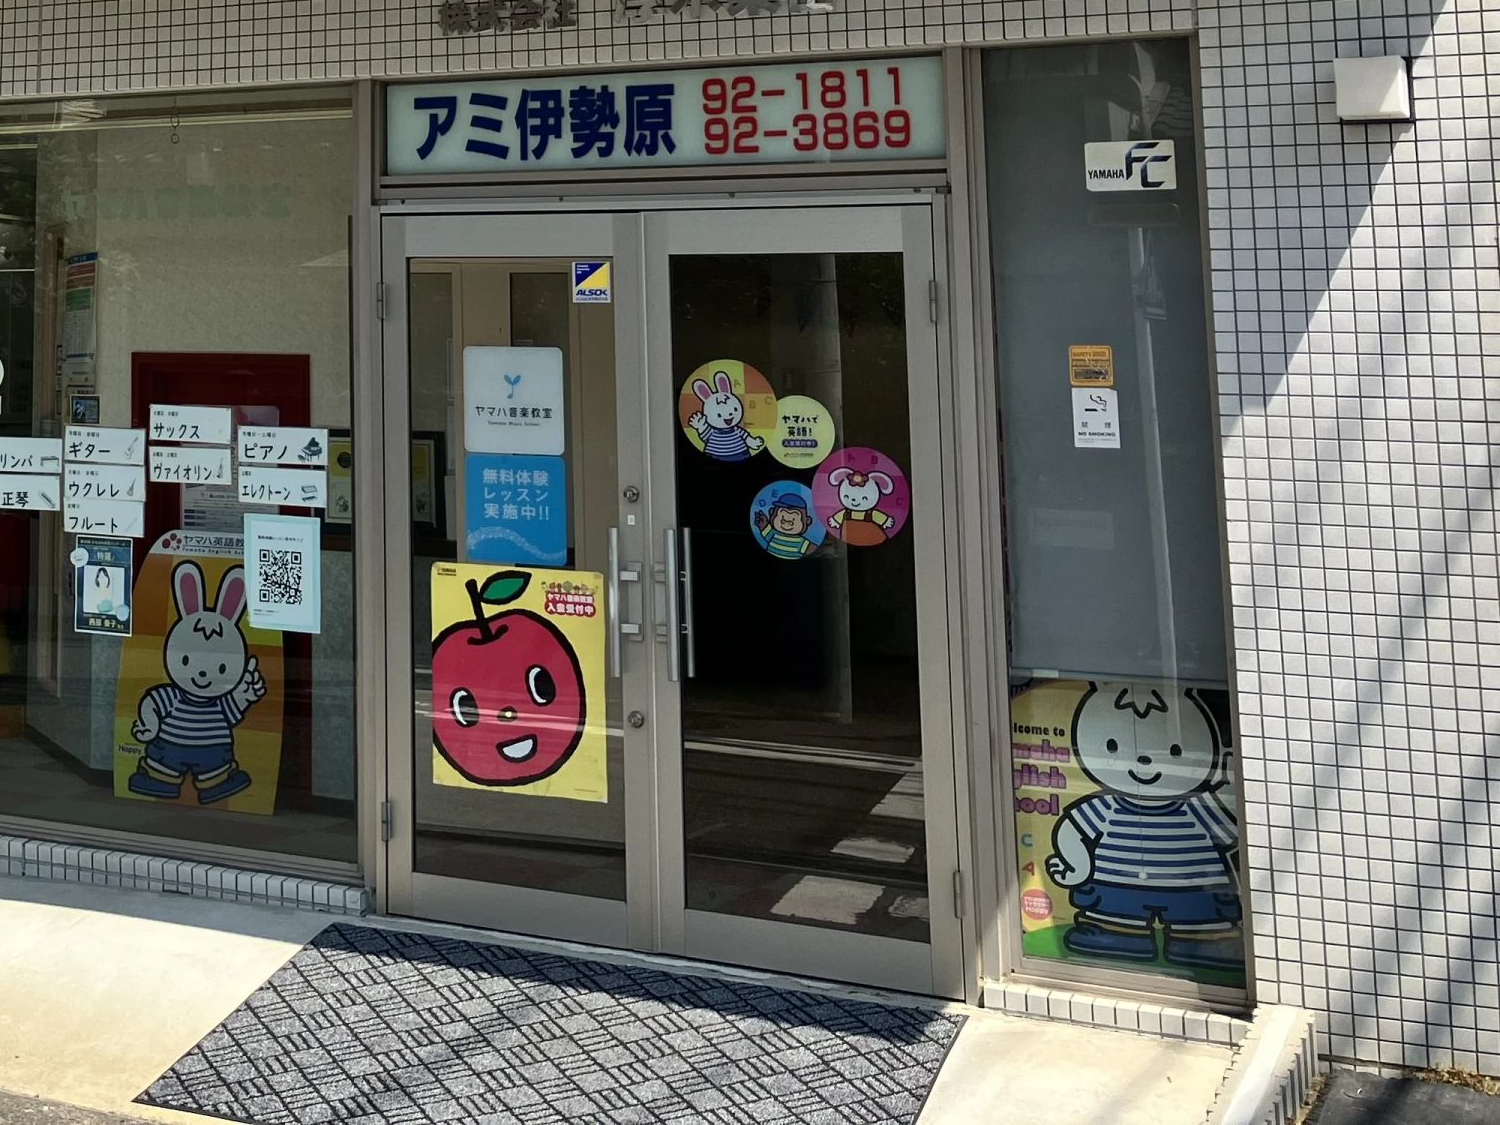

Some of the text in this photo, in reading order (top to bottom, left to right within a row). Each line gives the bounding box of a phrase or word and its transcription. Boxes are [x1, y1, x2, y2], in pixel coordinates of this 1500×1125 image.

[702, 66, 902, 115] 92-1811
[413, 82, 677, 161] アミ伊勢原
[703, 110, 911, 155] 92-3869
[1088, 169, 1125, 180] YAMAHA
[576, 289, 608, 297] ALSOK
[475, 406, 553, 420] ヤマハ音楽教室
[781, 414, 820, 425] ヤマハで
[153, 422, 201, 440] サックス
[68, 441, 111, 458] ギター
[244, 442, 288, 460] ピアノ
[153, 462, 212, 481] ヴァイオリン
[482, 467, 549, 487] 無料体験
[68, 481, 120, 498] ウクレレ
[241, 483, 291, 501] エレクトーン
[483, 487, 549, 503] レッスン
[483, 503, 550, 521] 実施中!!
[68, 516, 119, 534] フルート
[546, 603, 595, 616] 入会受付中
[1053, 725, 1066, 737] to
[1021, 833, 1034, 848] C
[1021, 860, 1035, 876] A
